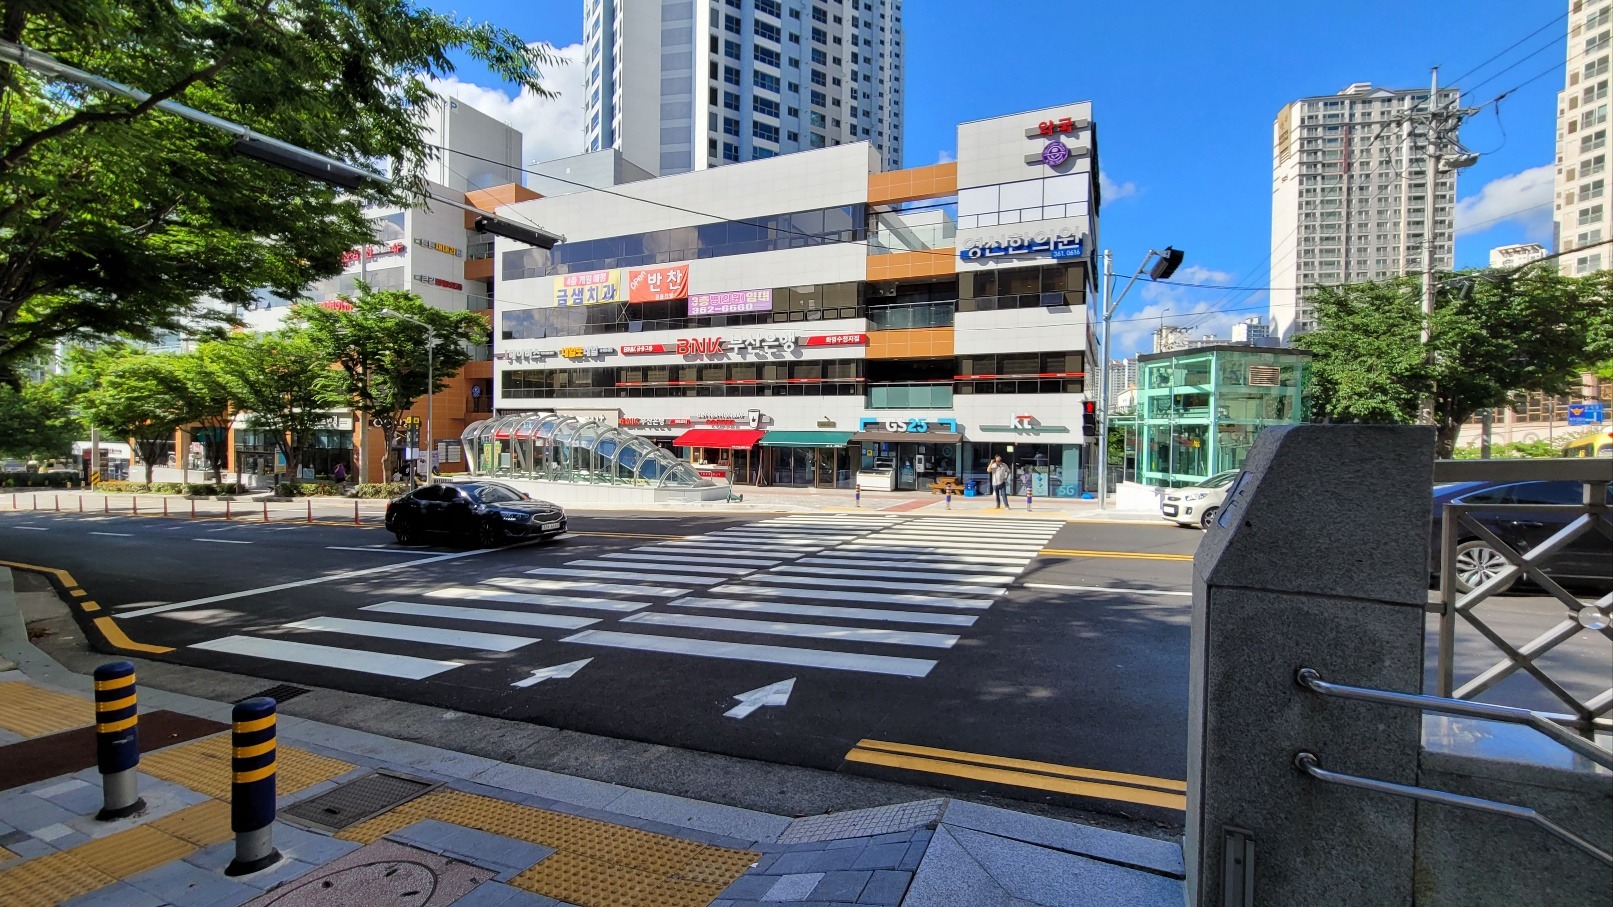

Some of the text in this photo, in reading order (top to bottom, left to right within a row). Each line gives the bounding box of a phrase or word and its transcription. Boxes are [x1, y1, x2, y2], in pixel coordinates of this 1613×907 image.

[1038, 117, 1073, 136] 약국
[647, 269, 682, 292] 반찬
[557, 284, 617, 306] 금샘치과
[676, 332, 796, 355] BNK 부산은행
[885, 419, 928, 432] GS25
